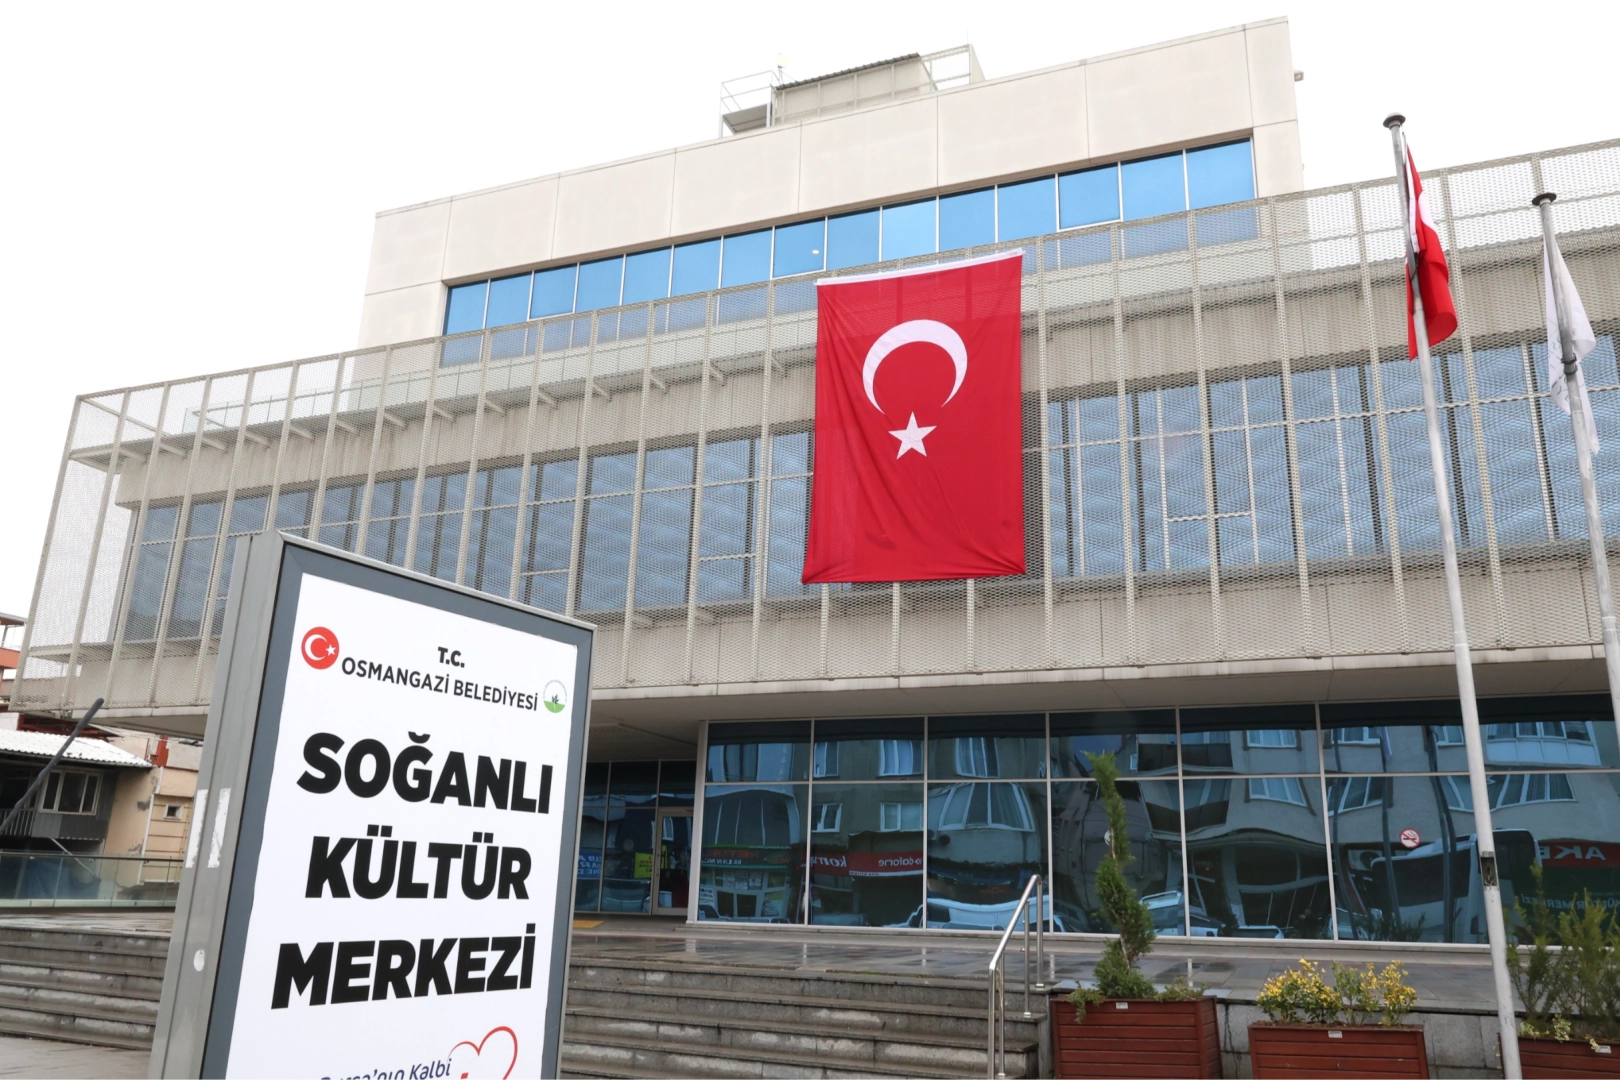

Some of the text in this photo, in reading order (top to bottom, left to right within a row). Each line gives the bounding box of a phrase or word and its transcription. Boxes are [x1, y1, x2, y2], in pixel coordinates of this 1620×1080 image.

[342, 656, 449, 694] OSMANGAZİ
[454, 680, 539, 711] BELEDİYESİ
[438, 647, 465, 667] T.C.
[297, 732, 554, 814] SOĞANLI
[306, 825, 532, 900] KÜLTÜR
[272, 924, 536, 1010] MERKEZİ
[409, 1058, 453, 1080] Kalbi
